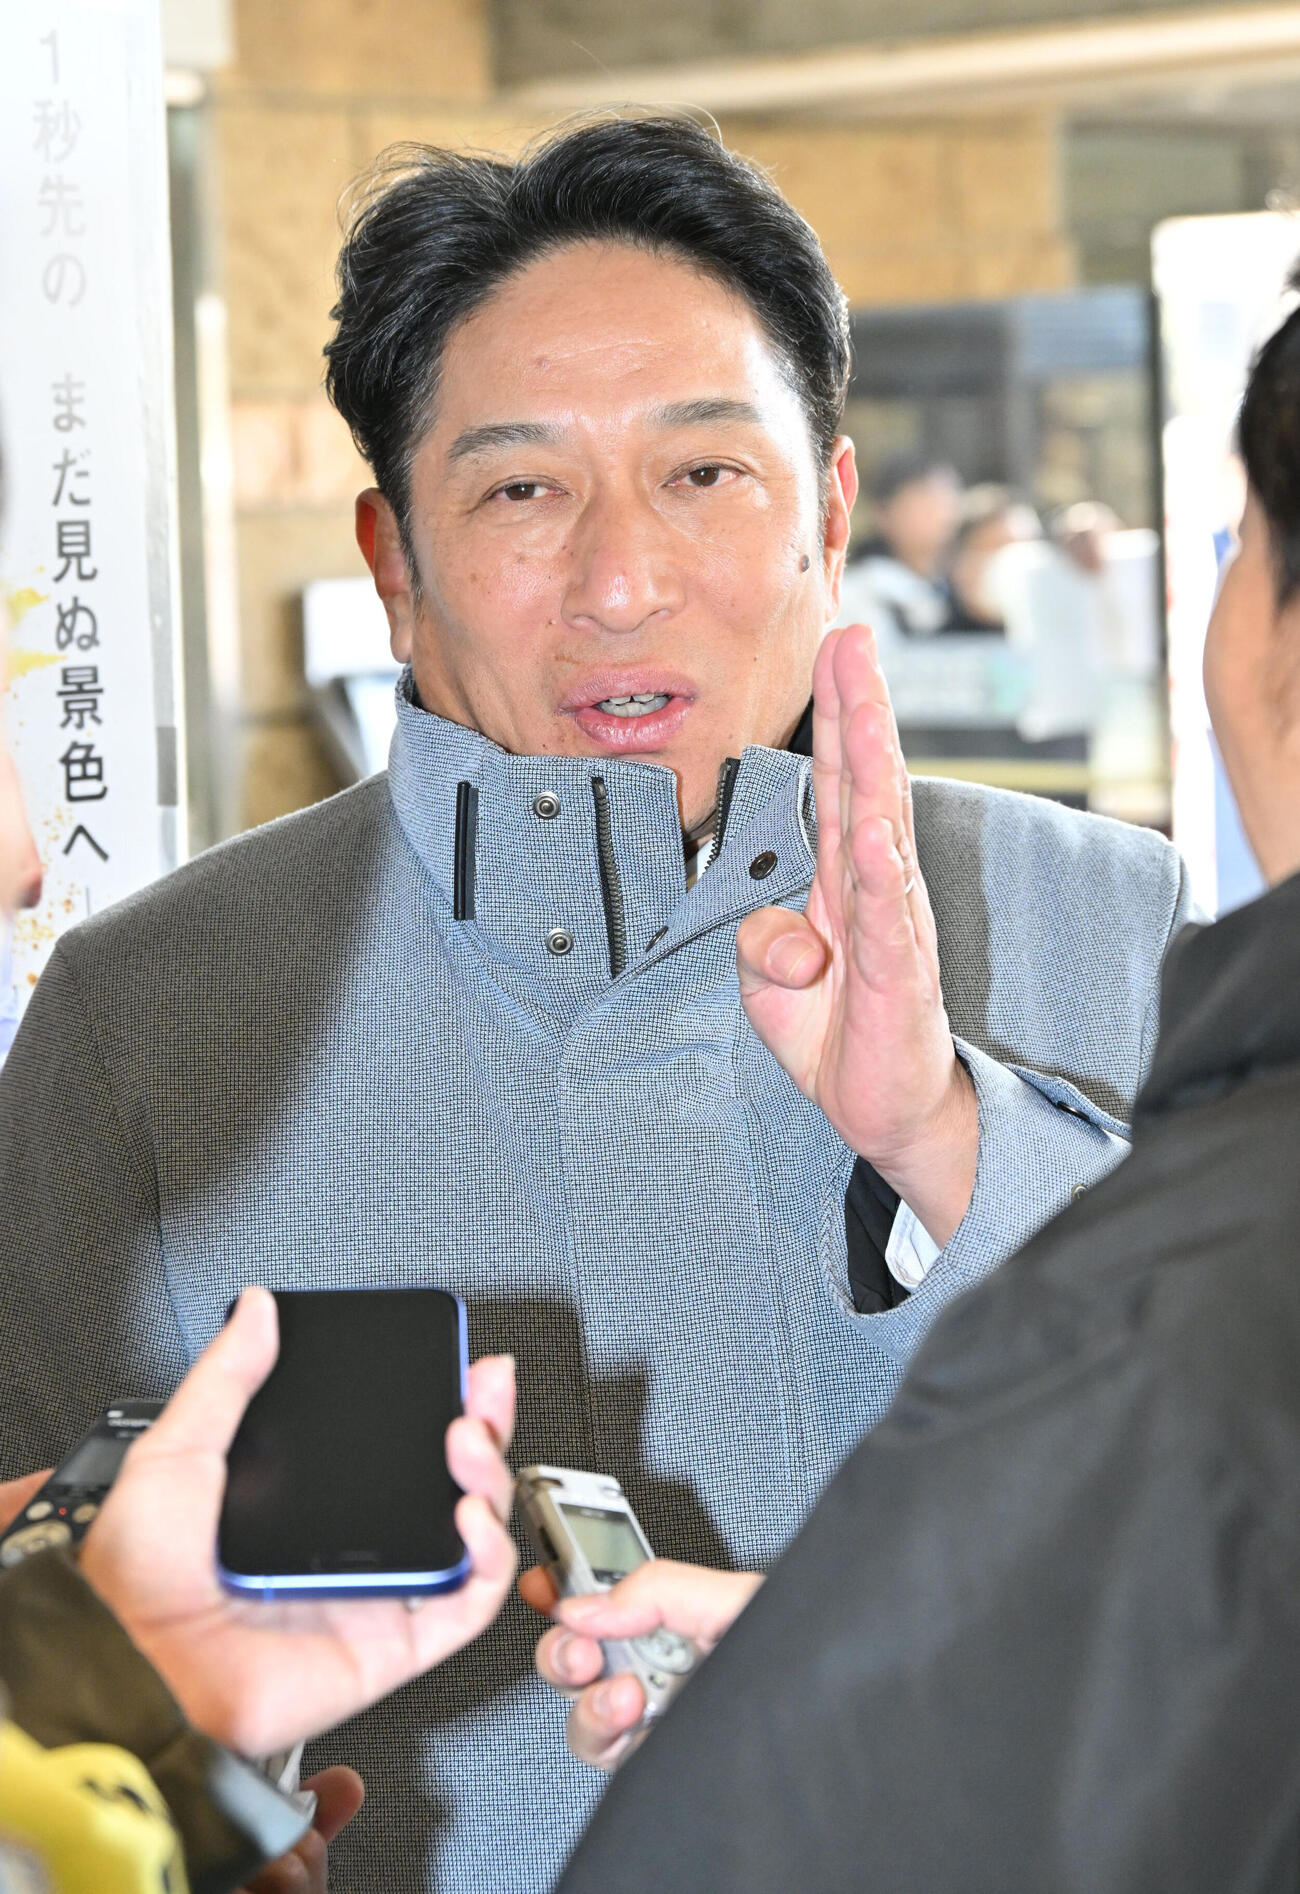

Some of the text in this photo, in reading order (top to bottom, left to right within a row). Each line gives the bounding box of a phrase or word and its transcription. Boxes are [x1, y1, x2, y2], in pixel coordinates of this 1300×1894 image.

[32, 28, 110, 864] 1秒先の まだ見ぬ景色へ
